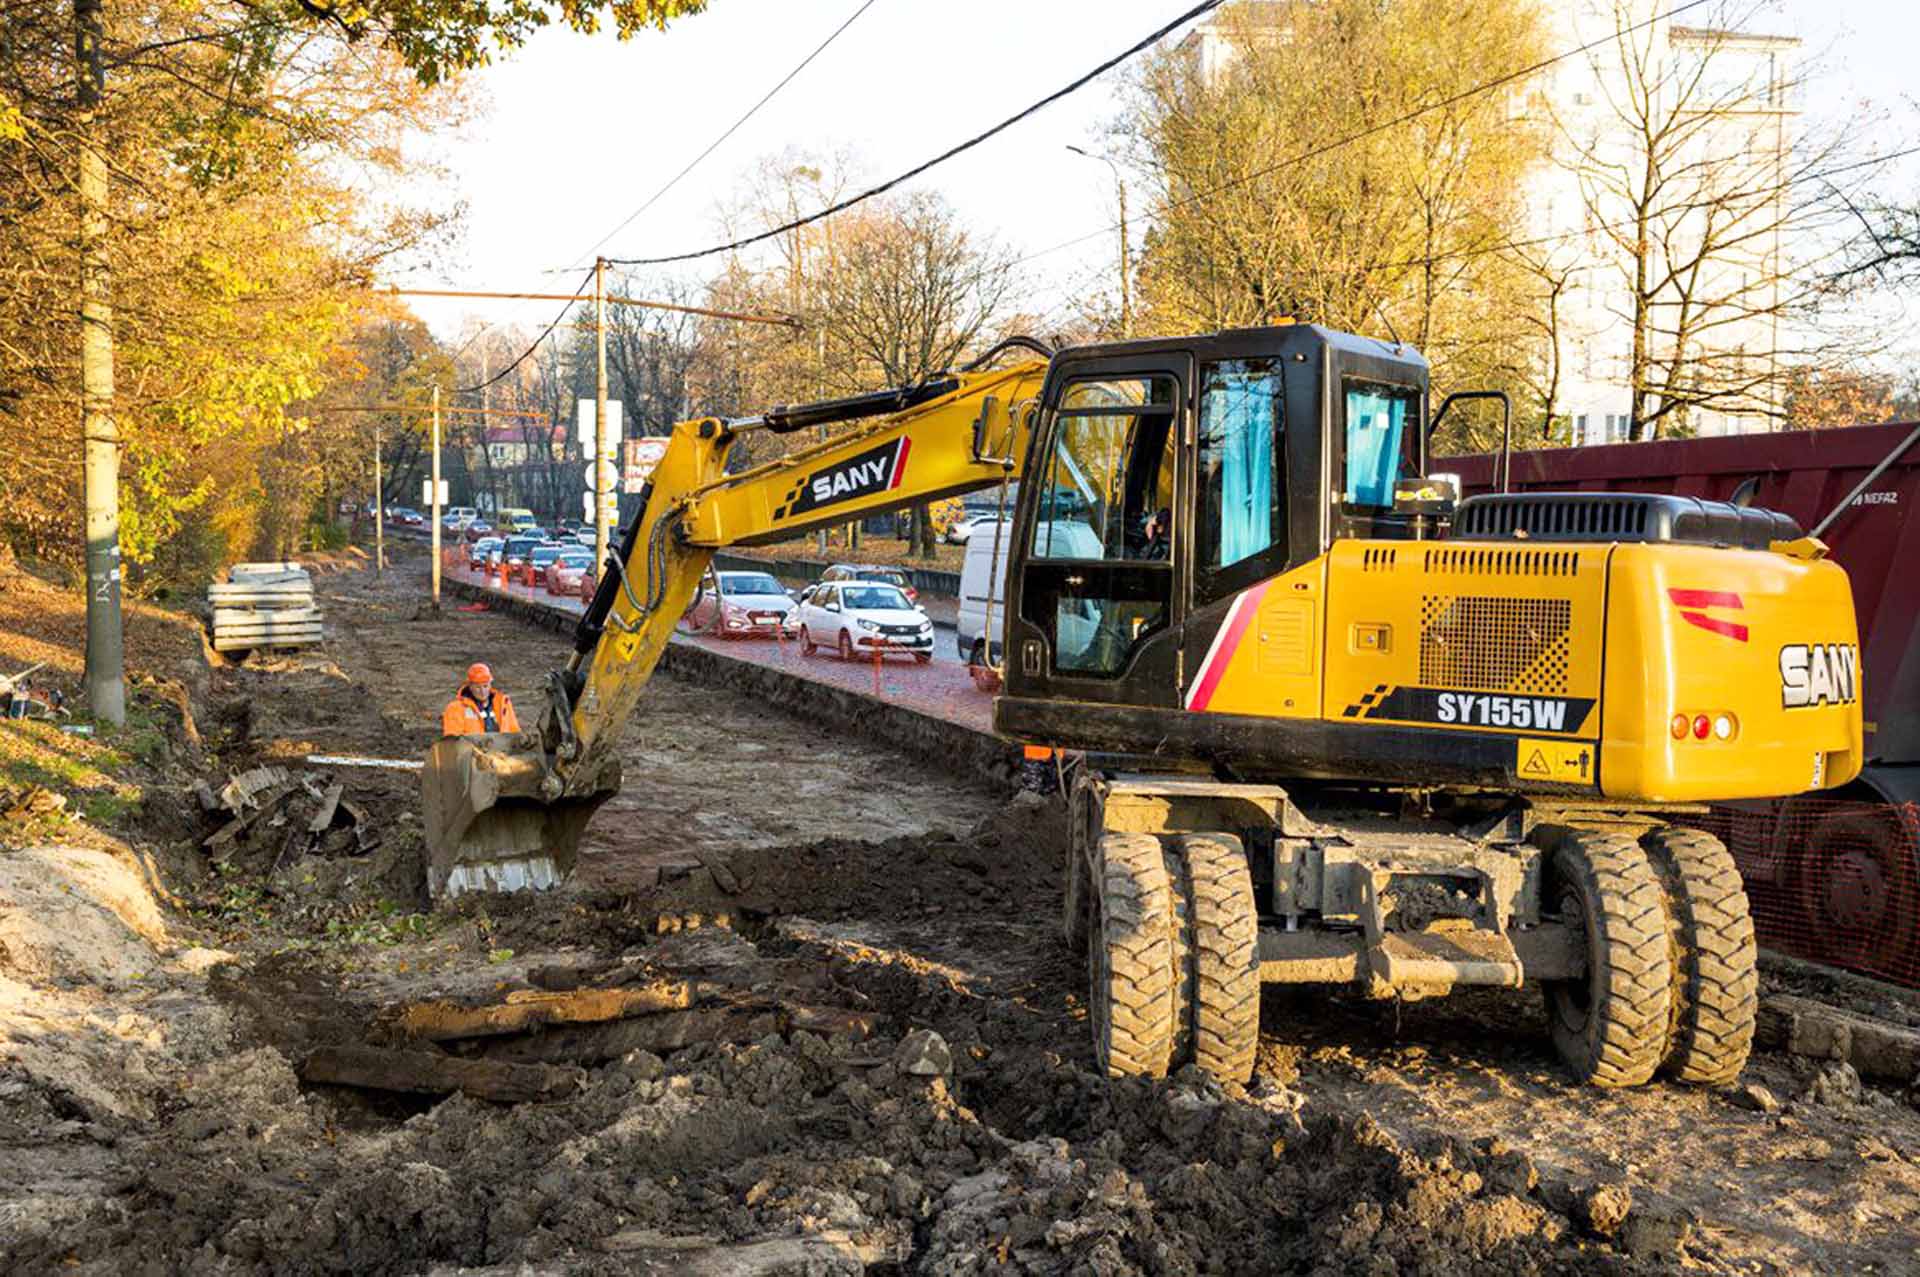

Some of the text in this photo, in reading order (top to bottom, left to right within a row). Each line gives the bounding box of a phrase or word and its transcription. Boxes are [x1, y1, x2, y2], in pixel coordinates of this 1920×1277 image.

[812, 456, 887, 502] SANY
[1864, 492, 1898, 505] NEFAZ
[1437, 692, 1566, 730] SY155W
